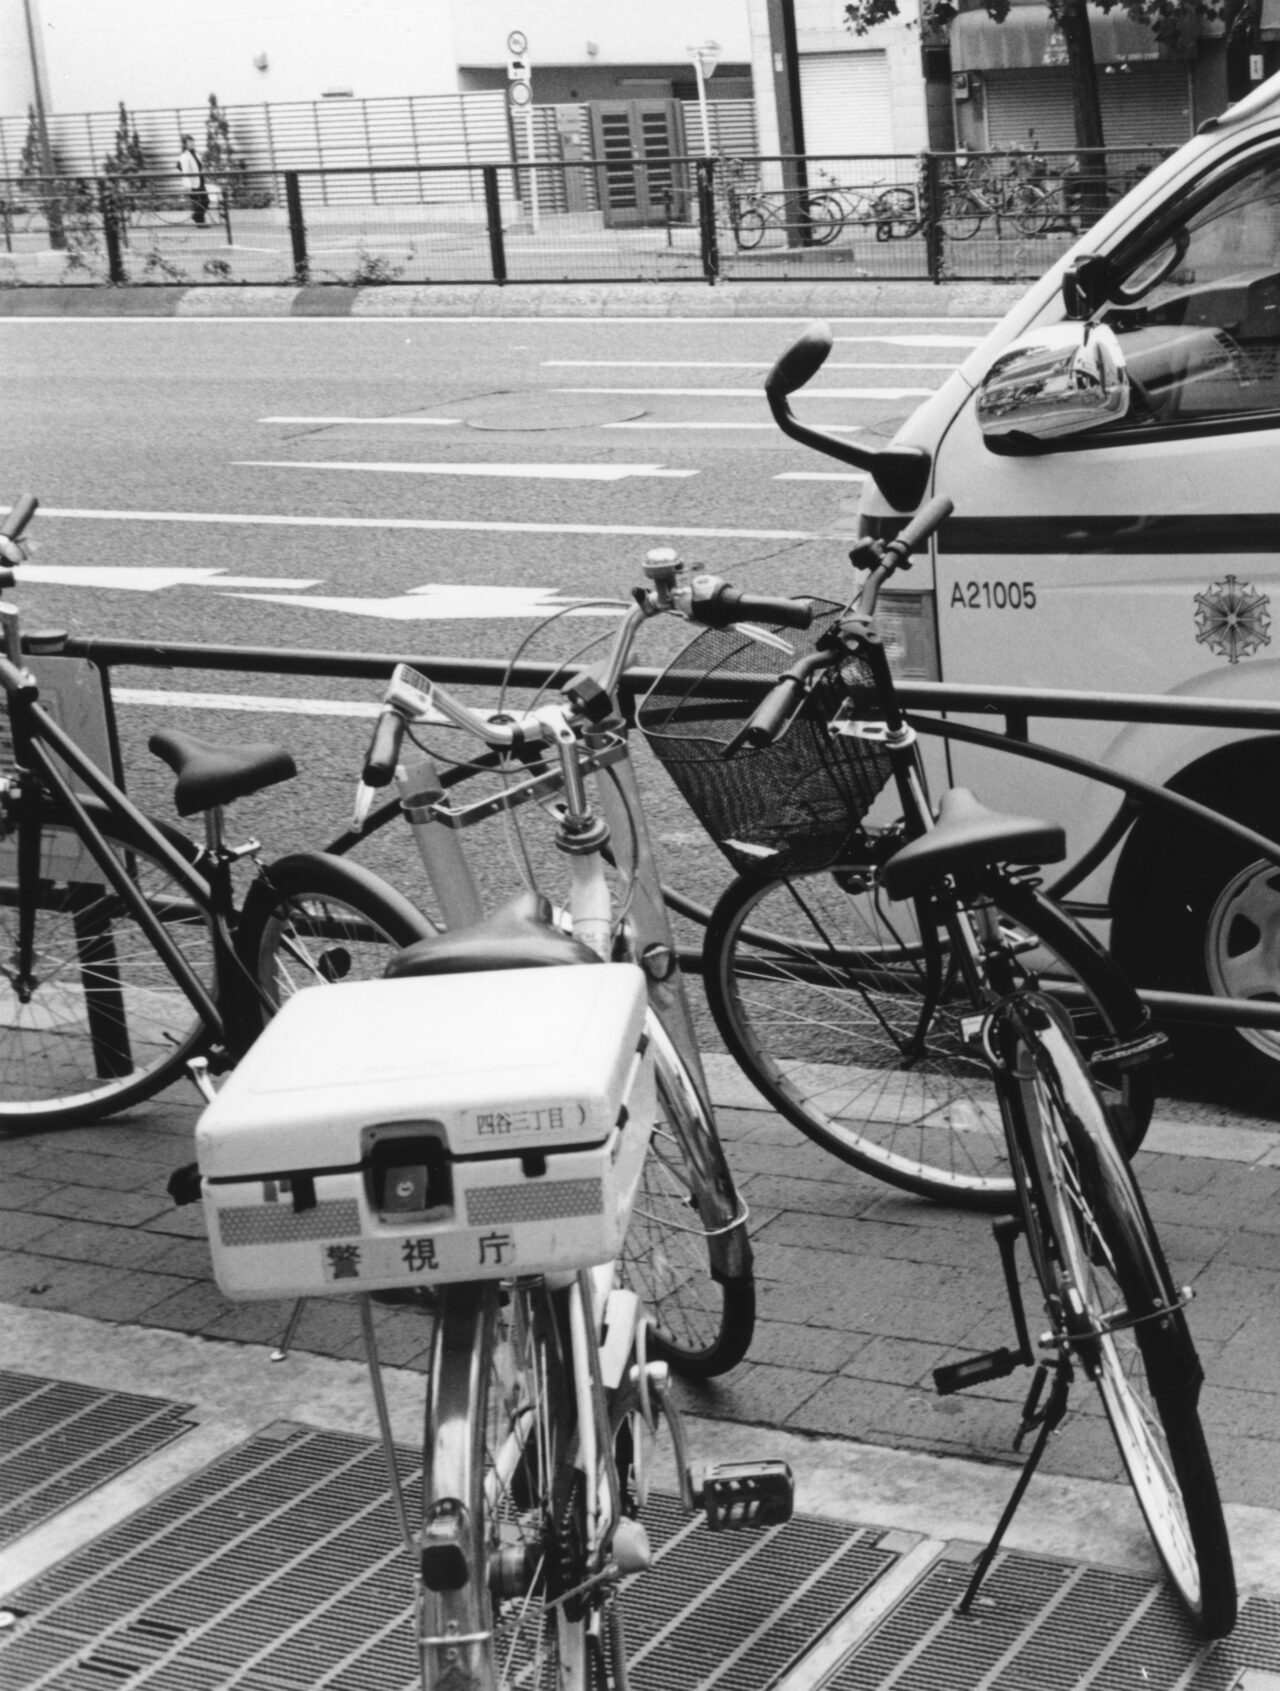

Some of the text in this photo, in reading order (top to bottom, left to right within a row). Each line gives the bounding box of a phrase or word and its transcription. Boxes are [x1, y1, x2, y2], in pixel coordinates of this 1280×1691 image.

[950, 581, 1037, 610] A21005
[476, 1107, 564, 1136] 四谷三丁目
[326, 1231, 510, 1280] 警視庁
